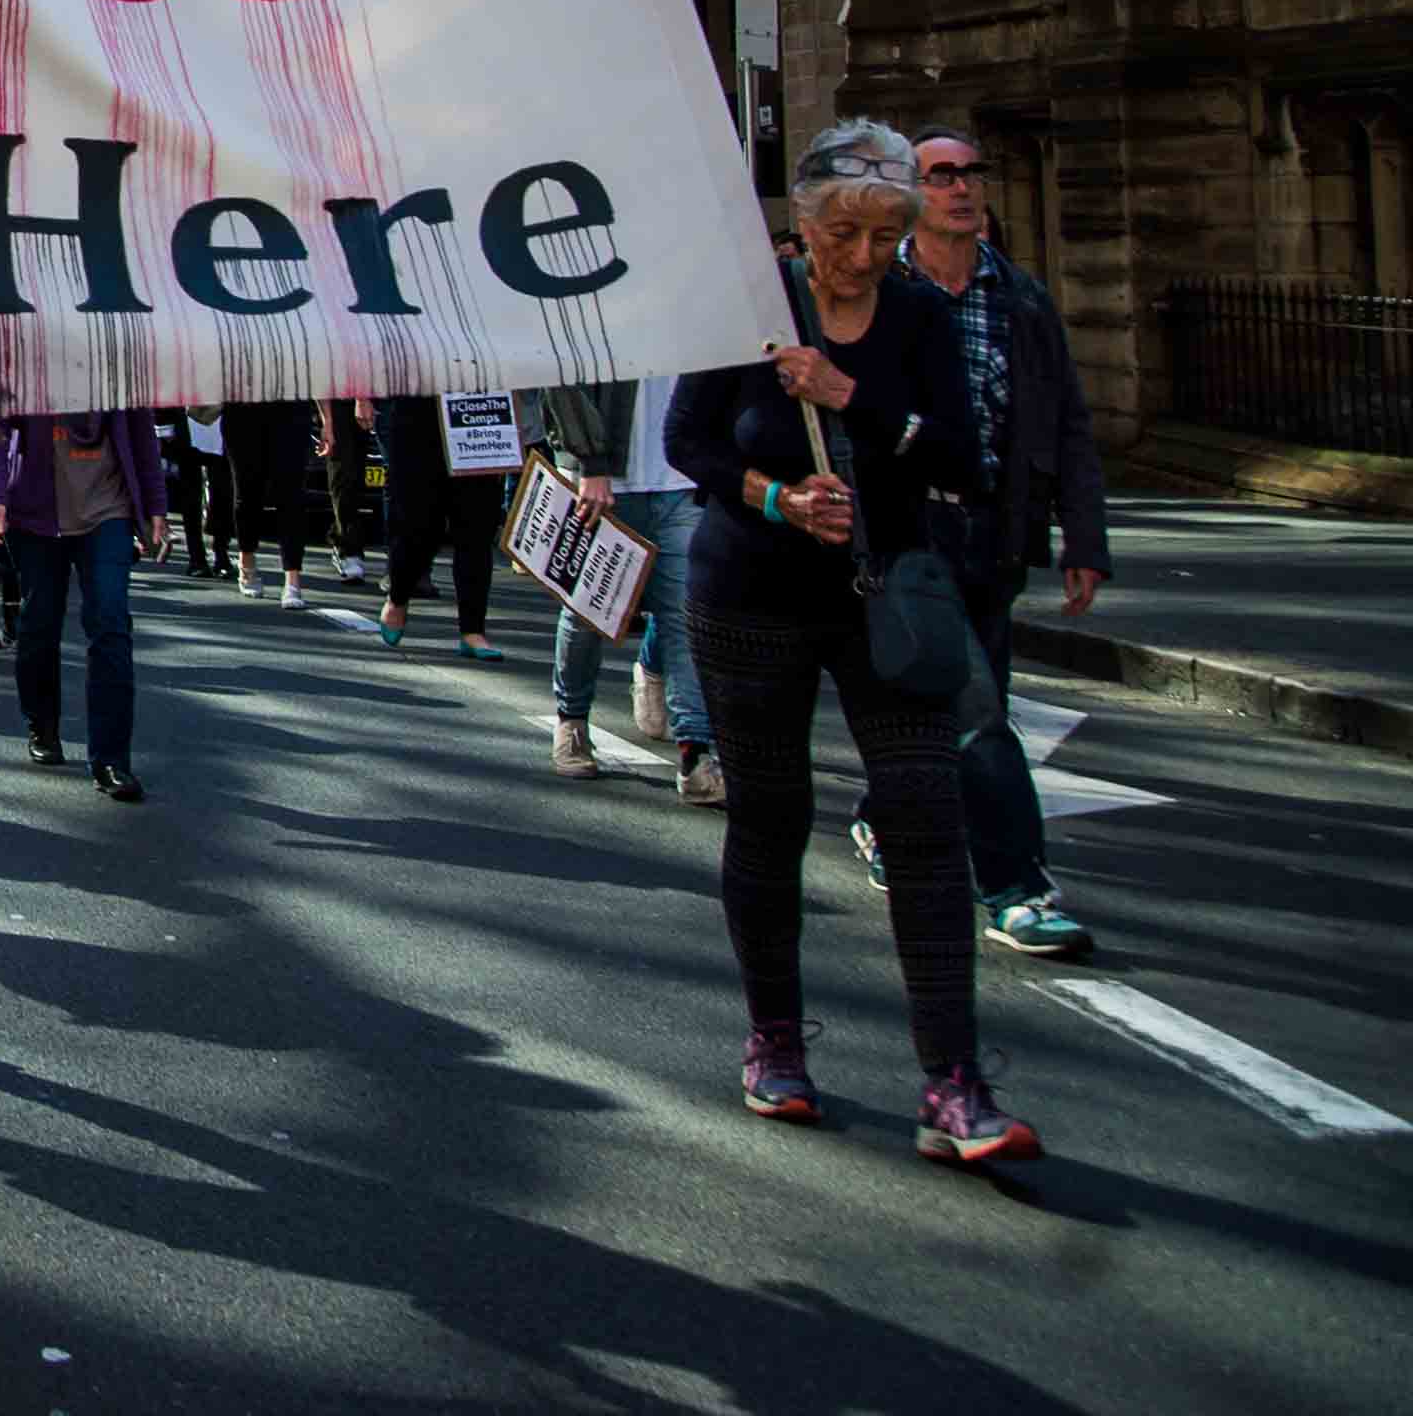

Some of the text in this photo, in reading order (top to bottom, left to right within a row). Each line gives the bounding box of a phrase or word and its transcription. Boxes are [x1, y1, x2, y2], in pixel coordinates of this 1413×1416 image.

[461, 413, 501, 425] Camps
[523, 484, 554, 556] #LetThem
[540, 513, 560, 548] Stay
[549, 511, 582, 579] #CloseTh
[566, 528, 592, 577] Camps
[583, 544, 608, 589] #Bring
[588, 542, 624, 611] ThemHere
